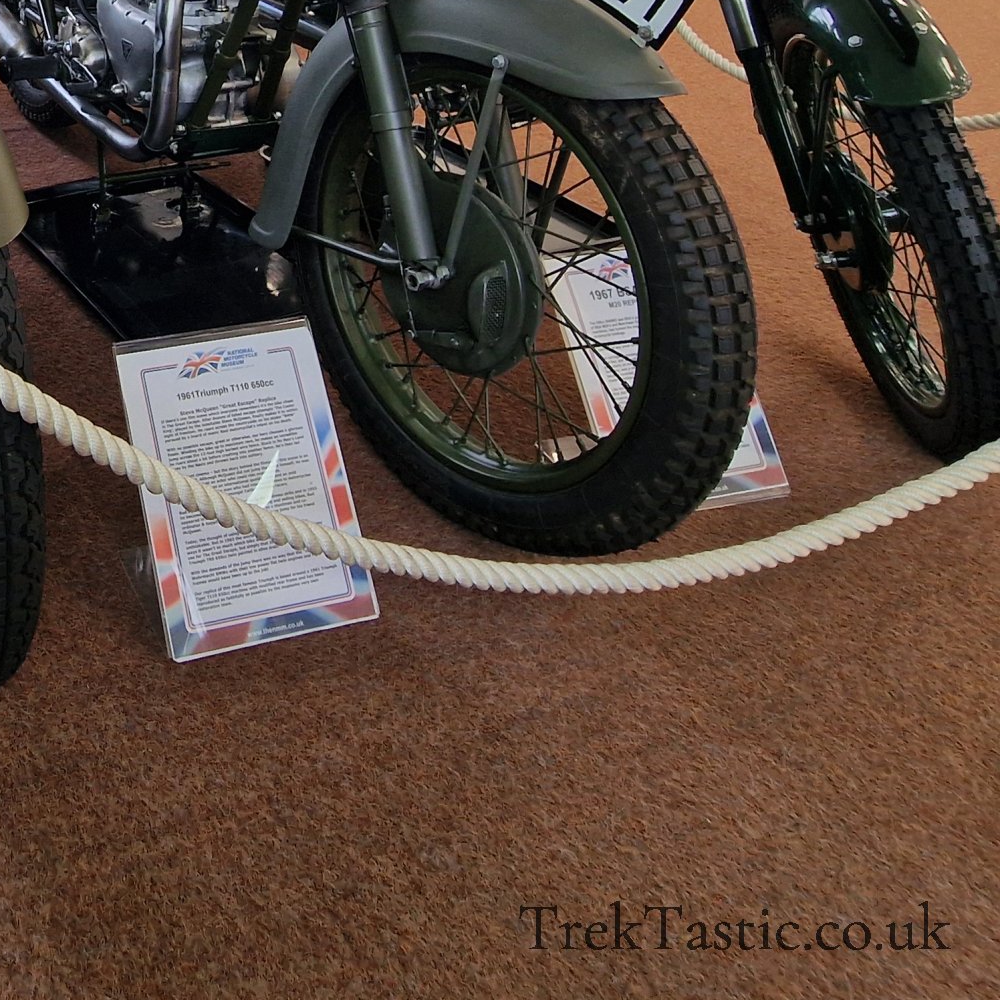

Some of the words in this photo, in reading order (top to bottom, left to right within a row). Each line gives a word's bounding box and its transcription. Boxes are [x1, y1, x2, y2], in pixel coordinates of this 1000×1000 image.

[589, 288, 613, 301] 1967
[227, 347, 254, 356] NATIONAL
[223, 352, 258, 361] MOTORCYCLE
[221, 359, 245, 368] MUSEUM
[230, 382, 250, 393] T110
[250, 379, 275, 390] 650cc
[195, 406, 219, 414] McQueen
